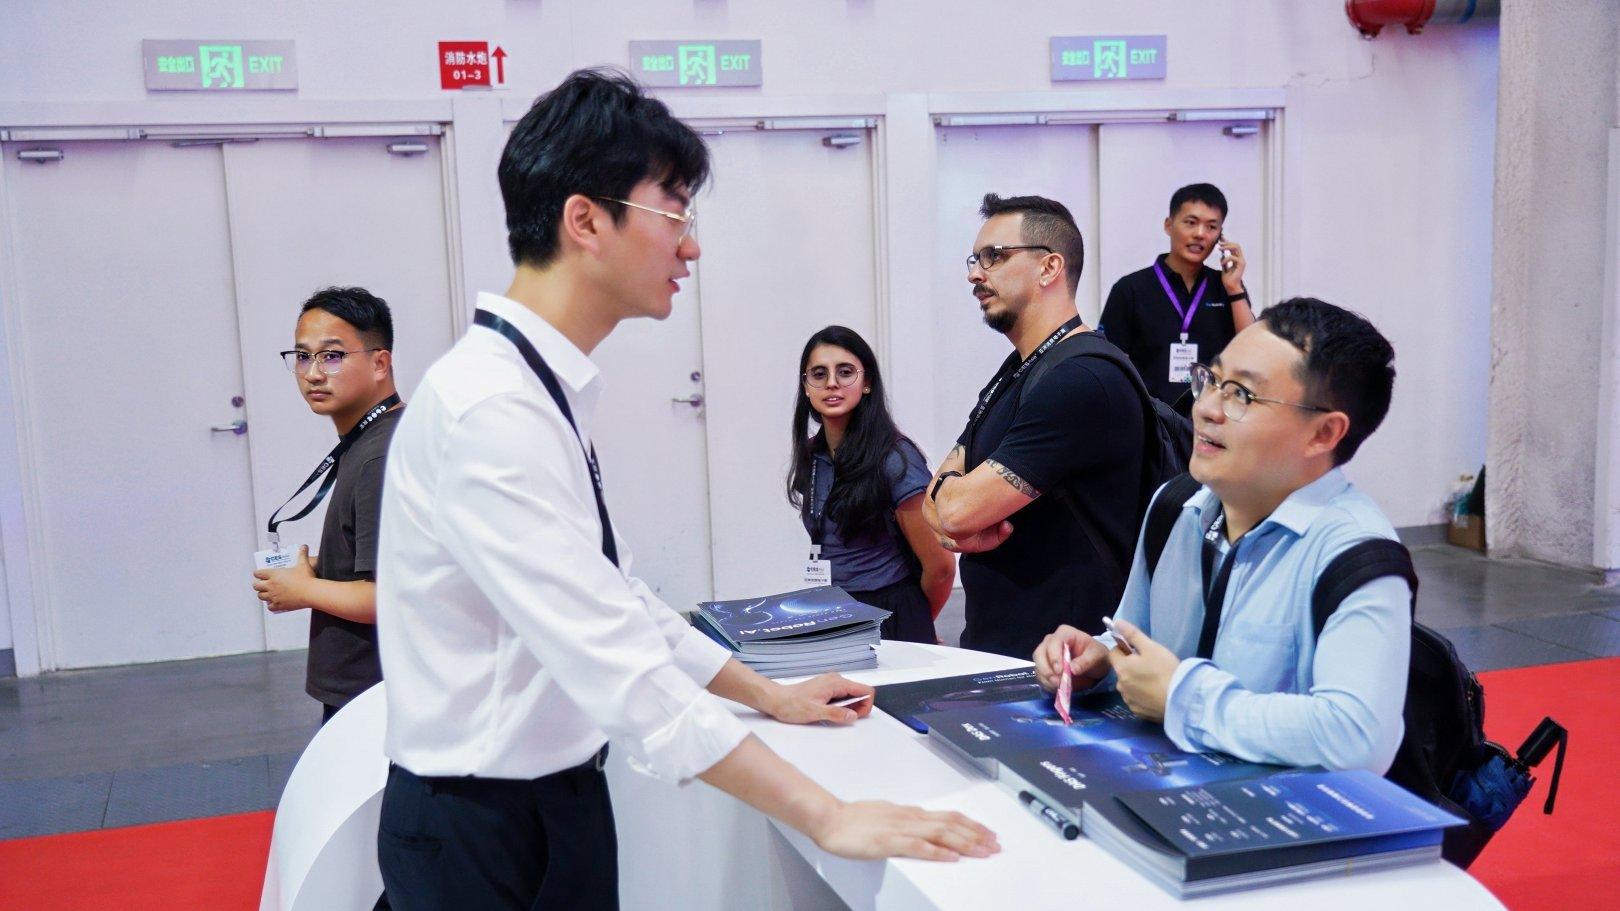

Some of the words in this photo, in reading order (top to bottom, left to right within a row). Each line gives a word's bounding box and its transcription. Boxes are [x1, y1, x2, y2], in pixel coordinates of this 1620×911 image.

[444, 51, 487, 66] 消防水炮
[720, 54, 750, 71] EXIT
[1130, 49, 1157, 64] EXIT
[248, 56, 283, 73] EXIT
[453, 70, 482, 80] 01-3
